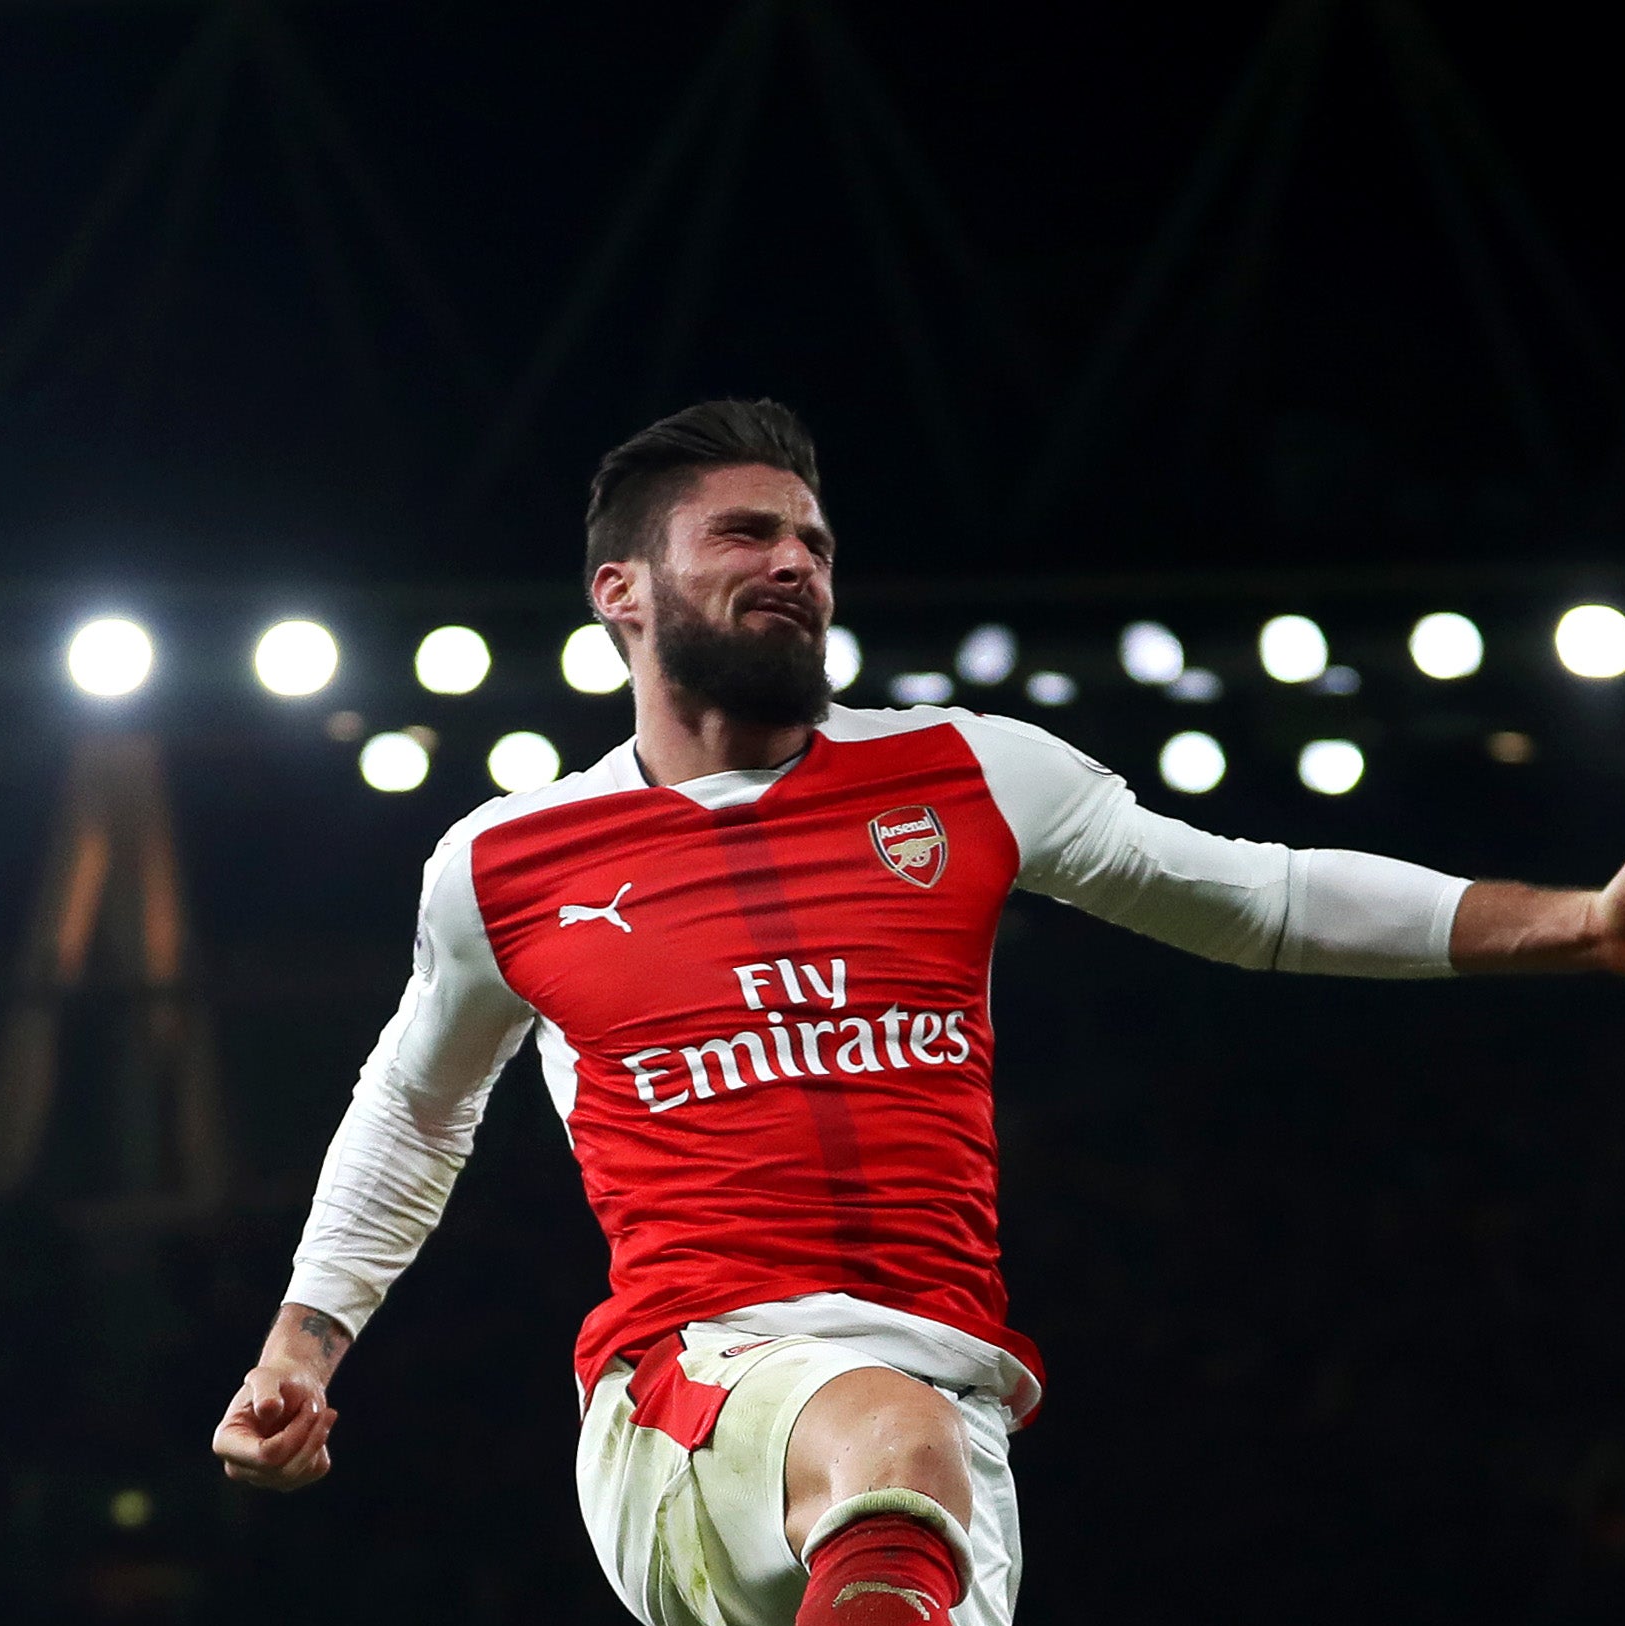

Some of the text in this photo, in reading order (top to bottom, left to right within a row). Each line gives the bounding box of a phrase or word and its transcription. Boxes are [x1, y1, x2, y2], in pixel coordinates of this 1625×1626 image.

[880, 815, 933, 840] Arsenal
[733, 958, 847, 1011] Fly
[621, 1002, 970, 1114] Emirates
